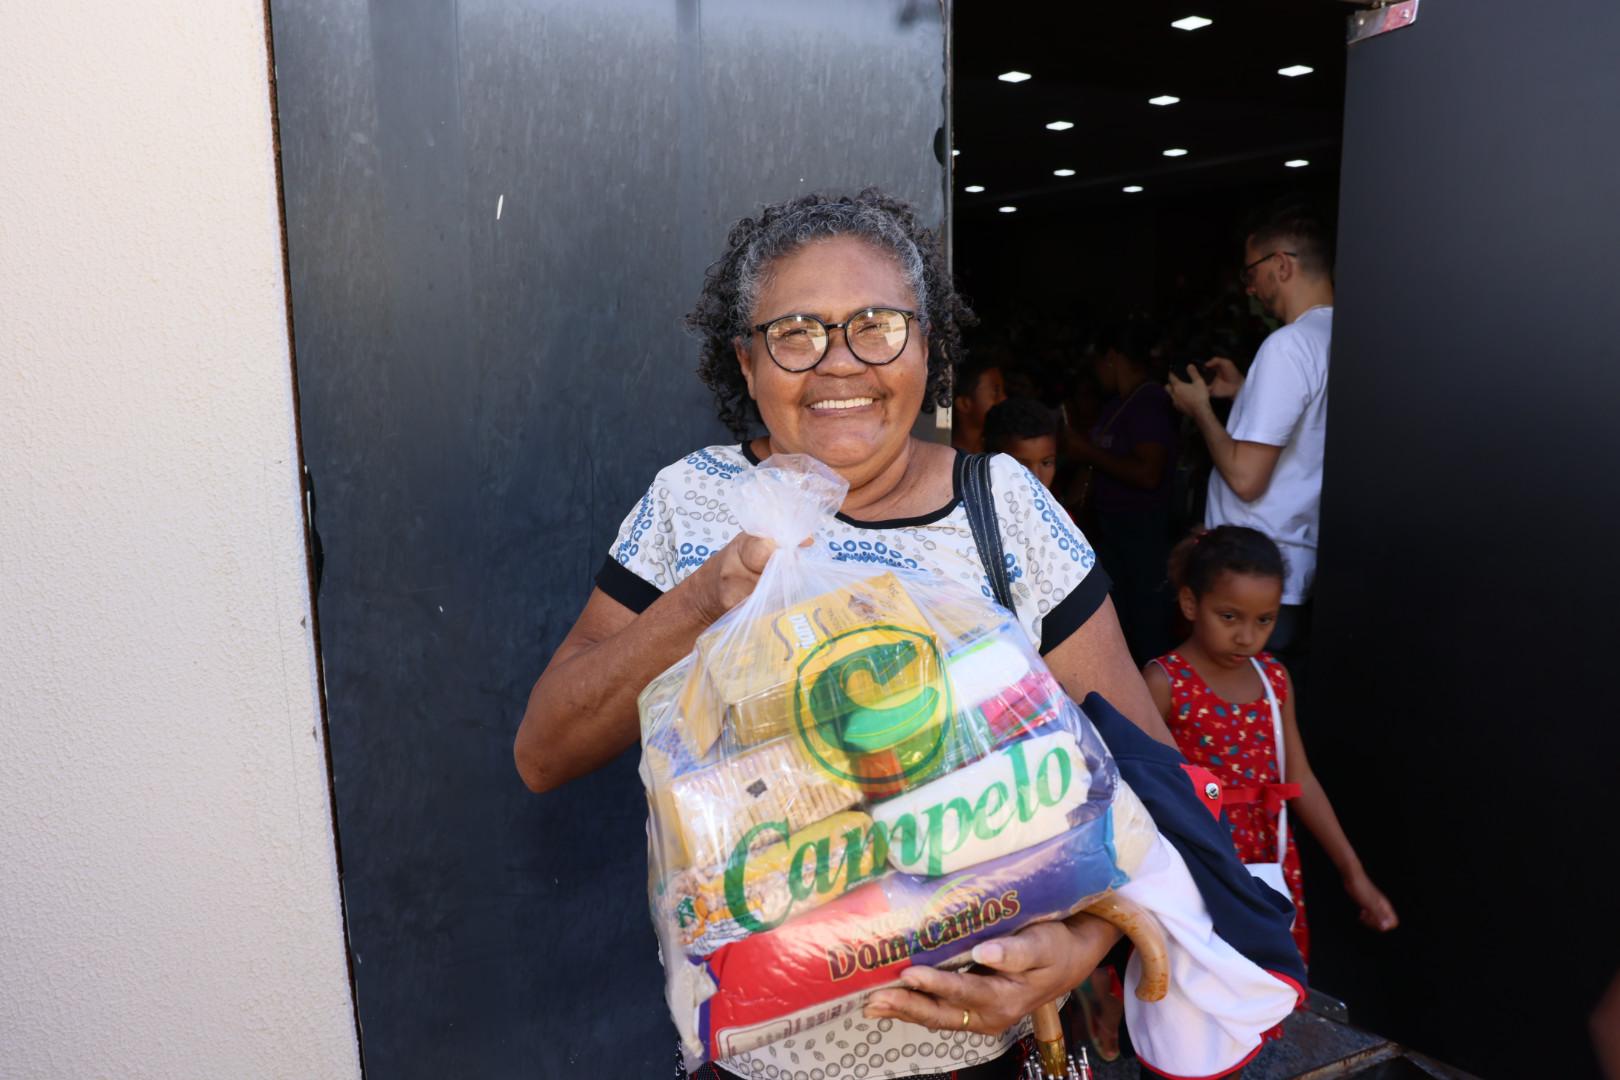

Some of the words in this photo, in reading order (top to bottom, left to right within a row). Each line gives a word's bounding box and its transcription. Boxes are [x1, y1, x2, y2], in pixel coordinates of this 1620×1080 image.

[724, 741, 1072, 933] Campelo
[827, 935, 911, 980] Dom
[918, 889, 1021, 950] Carlos
